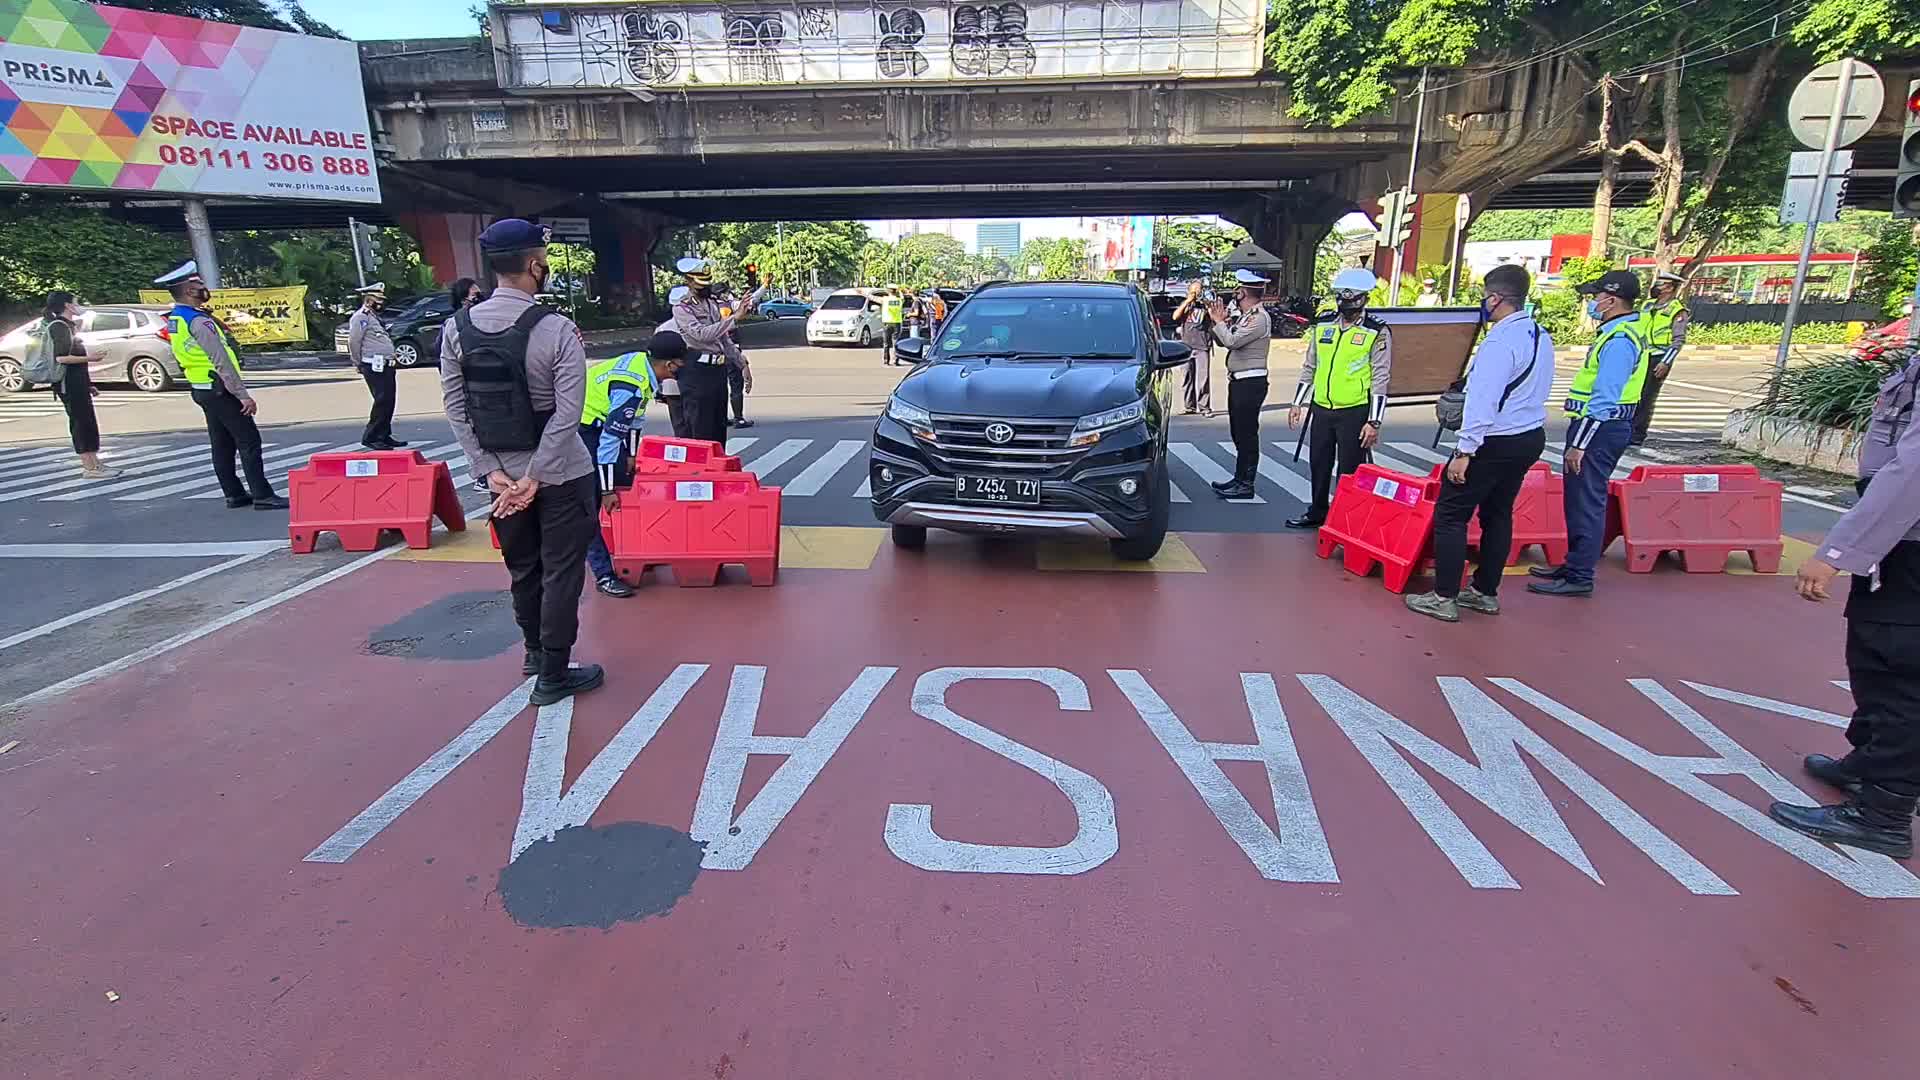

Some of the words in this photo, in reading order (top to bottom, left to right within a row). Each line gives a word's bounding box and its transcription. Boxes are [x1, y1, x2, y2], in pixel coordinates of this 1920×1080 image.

[151, 115, 237, 140] SPACE
[243, 124, 367, 150] AVAILABLE
[159, 144, 251, 170] 08111
[263, 152, 314, 173] 306
[322, 156, 370, 176] 888
[267, 181, 375, 193] www.prisma-ads.com
[214, 303, 252, 311] DIMANA
[260, 299, 288, 307] MANA
[958, 477, 966, 492] B
[976, 478, 1006, 493] 2454
[1015, 480, 1037, 496] TZY
